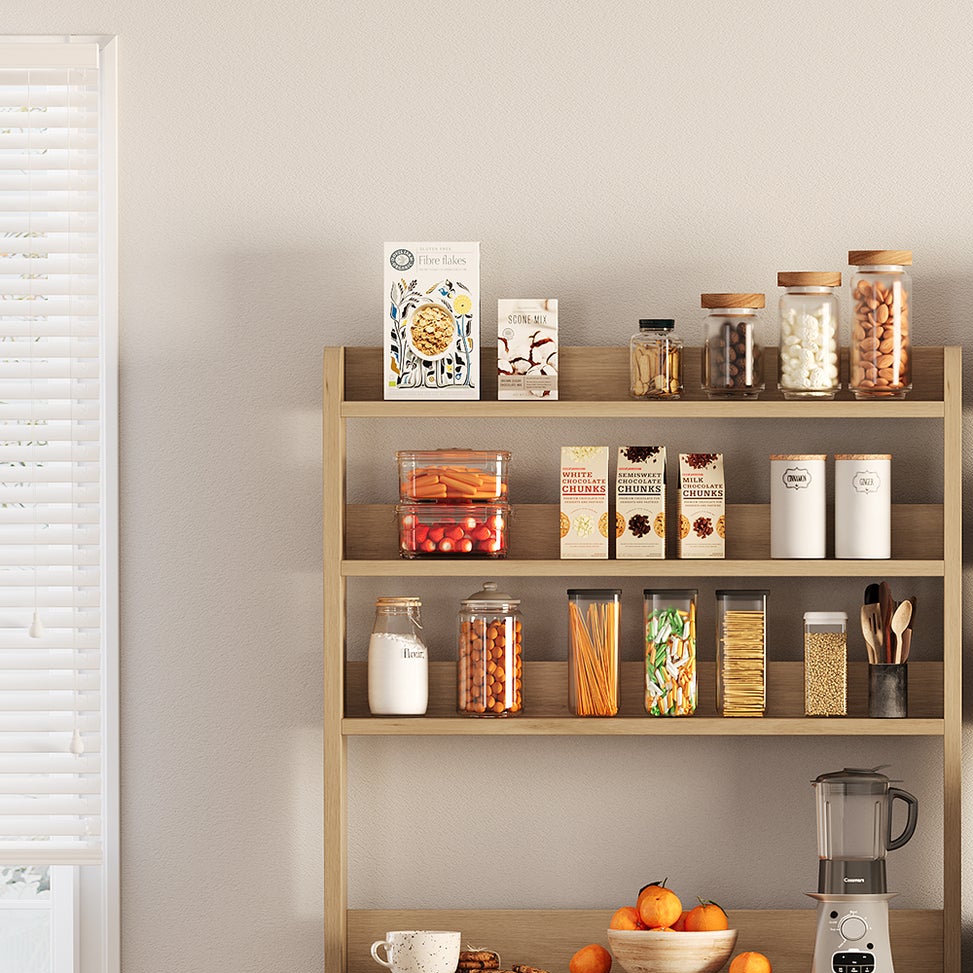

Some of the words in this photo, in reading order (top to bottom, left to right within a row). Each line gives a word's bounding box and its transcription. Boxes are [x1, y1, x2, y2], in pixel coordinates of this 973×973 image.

[418, 255, 441, 265] Fibre
[442, 255, 467, 265] flakes
[508, 315, 531, 324] SCONE
[534, 315, 547, 324] MIX
[562, 485, 606, 493] CHUNKS
[617, 485, 661, 493] CHUNKS
